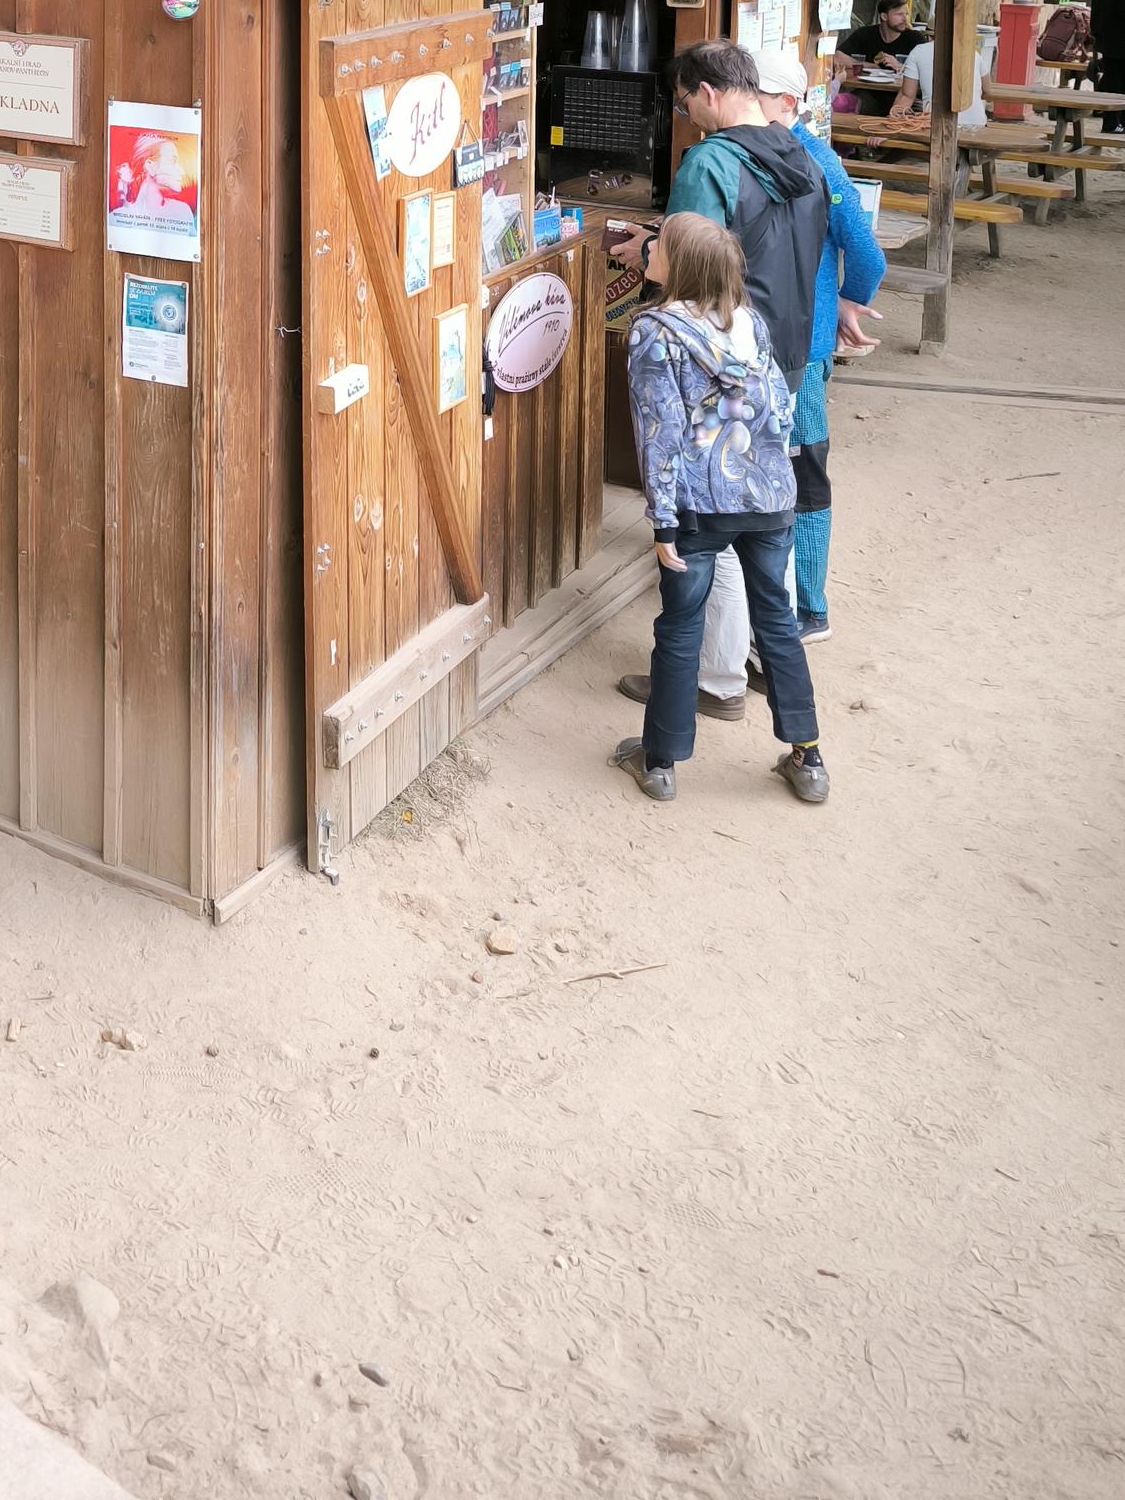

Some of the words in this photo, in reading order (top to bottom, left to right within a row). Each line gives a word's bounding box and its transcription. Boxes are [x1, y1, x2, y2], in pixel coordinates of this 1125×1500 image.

[22, 60, 42, 69] HRAD
[409, 81, 446, 166] Kitl
[498, 303, 542, 354] Vilémova
[545, 283, 566, 306] káva
[543, 319, 560, 337] 1910
[497, 367, 515, 384] vlastní
[515, 371, 539, 388] pražírny
[539, 361, 552, 376] stále
